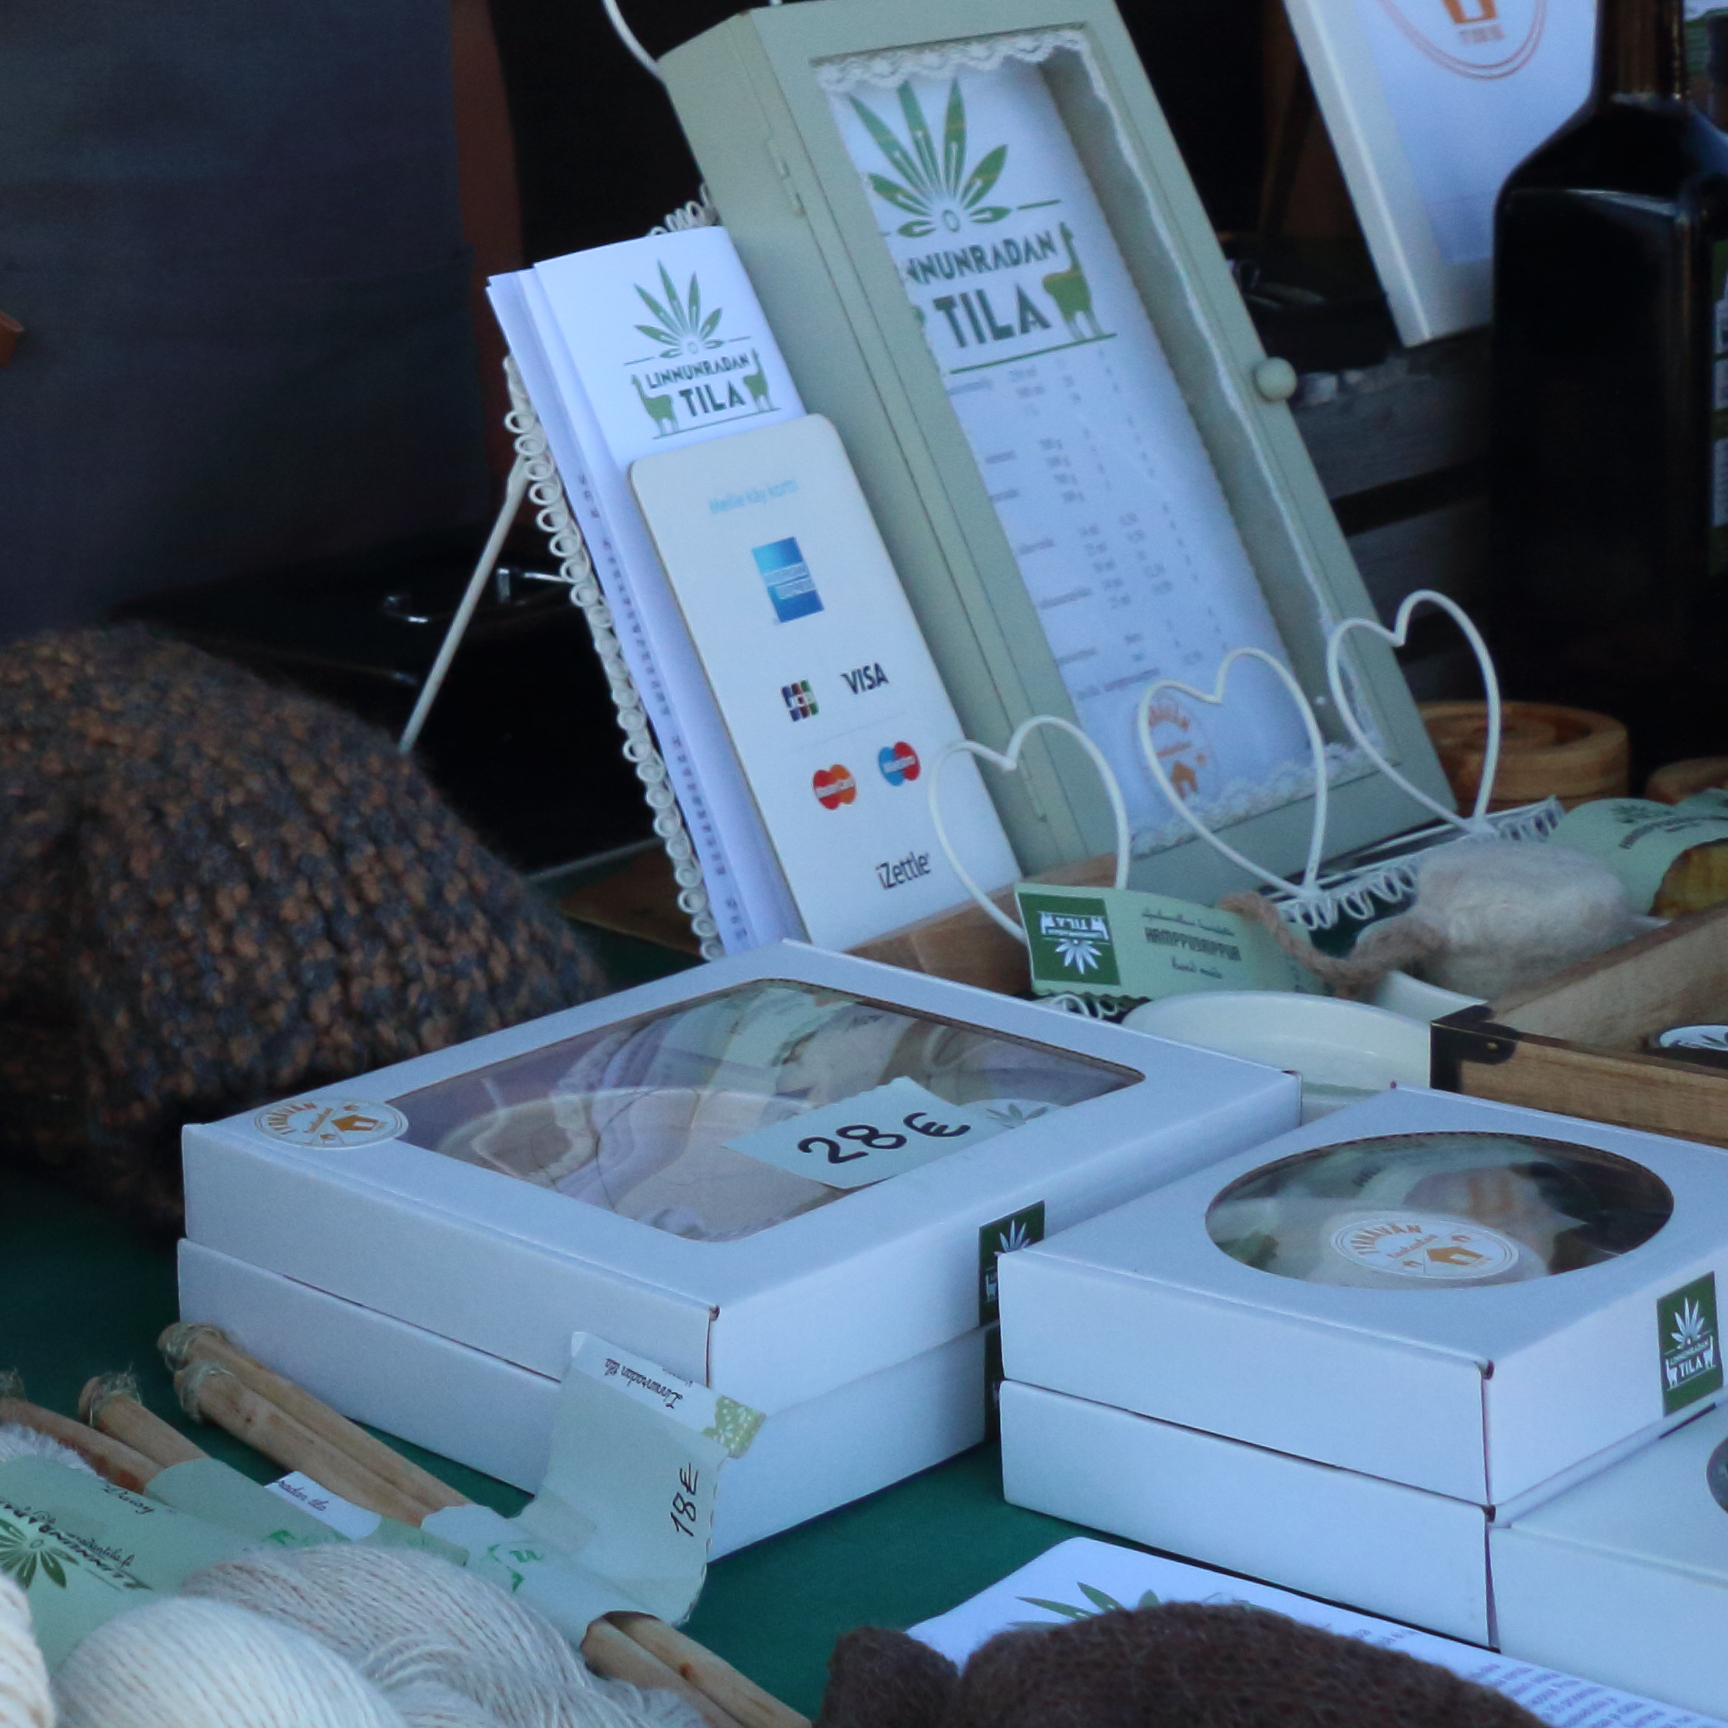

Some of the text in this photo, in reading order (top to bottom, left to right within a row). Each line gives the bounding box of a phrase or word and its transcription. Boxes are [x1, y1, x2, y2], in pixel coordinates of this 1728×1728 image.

[931, 282, 1052, 349] TILA
[645, 351, 753, 391] LINNUNRADAN
[678, 378, 747, 419] TILA
[840, 661, 890, 695] VISA
[875, 850, 932, 891] iZettle
[1679, 1355, 1703, 1379] TILA
